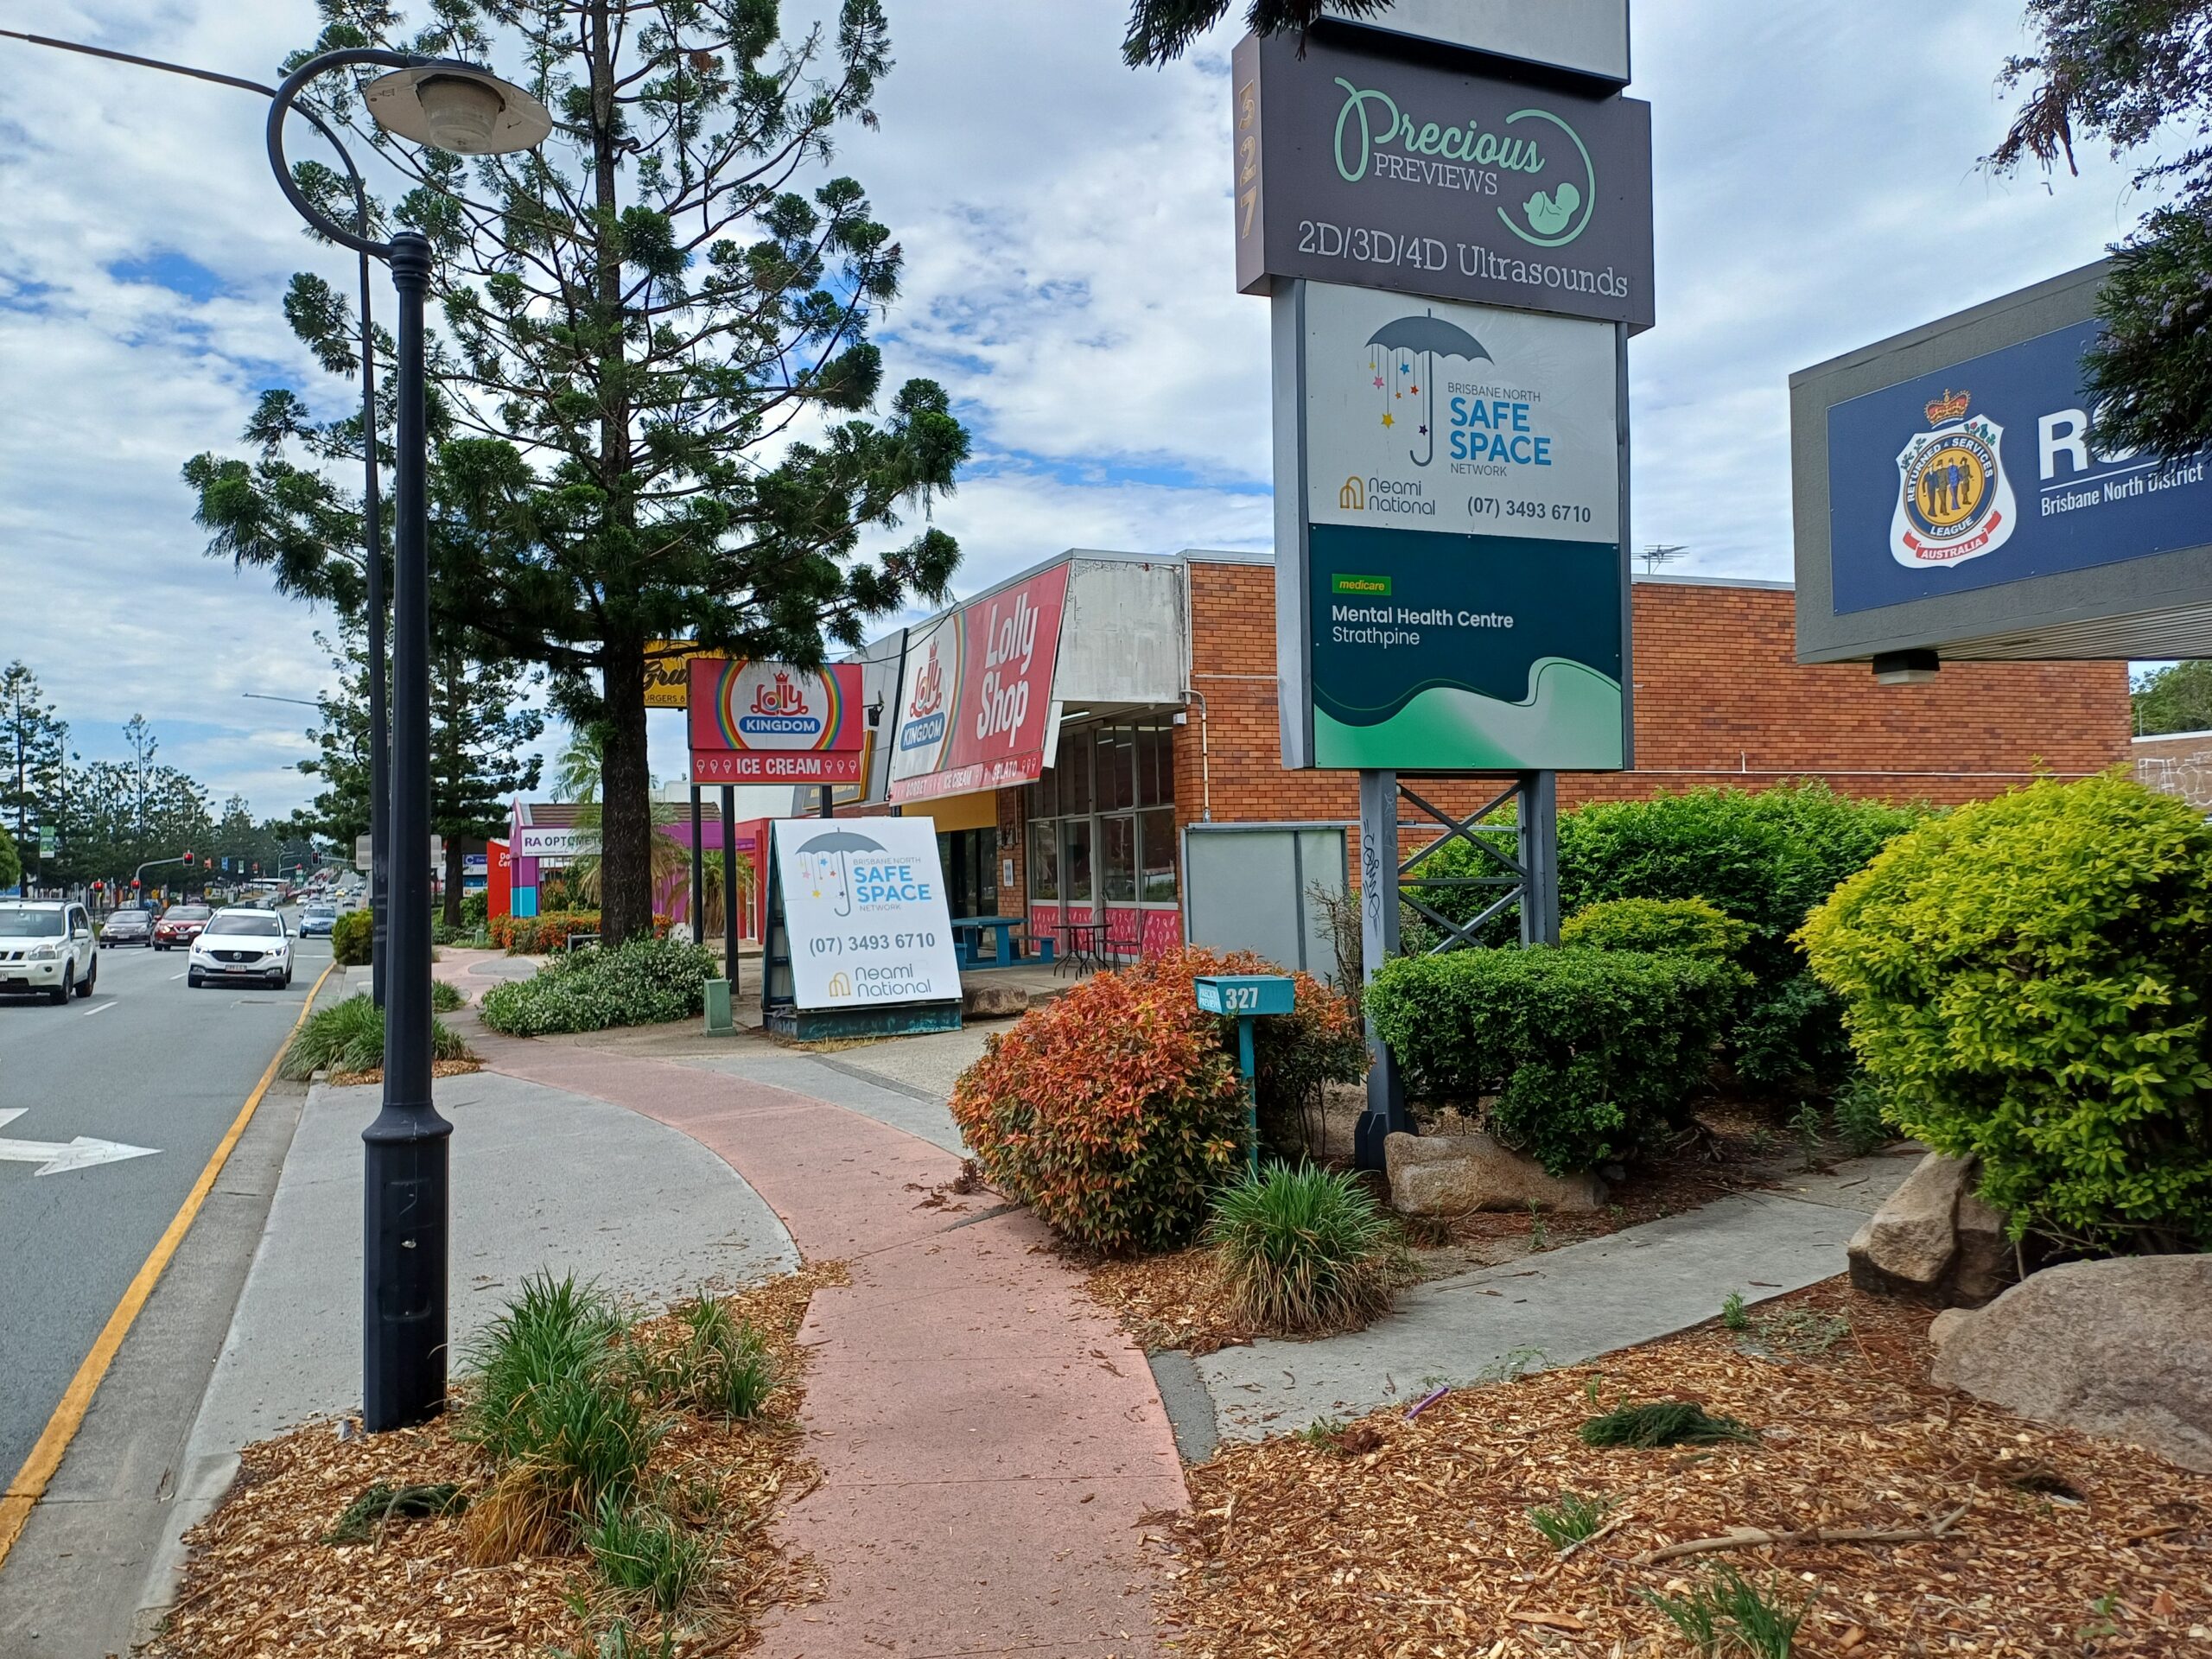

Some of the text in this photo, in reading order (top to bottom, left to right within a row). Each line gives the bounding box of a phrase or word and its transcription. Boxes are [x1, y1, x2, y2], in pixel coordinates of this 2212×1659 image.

[1333, 76, 1545, 182] Precious
[1374, 152, 1497, 195] PREVIEWS
[1298, 219, 1628, 298] 2D/3D/4D Ultrasounds
[1447, 382, 1541, 403] BRISBANE NORTH
[1450, 397, 1530, 432] SAFE
[1450, 429, 1552, 466] SPACE
[1451, 462, 1507, 477] NETWORK
[1907, 444, 1942, 502] RETURNED
[1952, 437, 1993, 478] SERVICES
[2041, 463, 2203, 517] Brisbane North District
[1467, 496, 1592, 523] (07) 3493 6710
[1929, 516, 1974, 537] LEAGUE
[1920, 538, 1984, 559] AUSTRALIA
[1339, 579, 1385, 591] medicare
[1332, 606, 1514, 629] Mental Health Centre
[984, 592, 1039, 676] Lolly
[1332, 626, 1421, 649] Strathpine
[750, 683, 809, 715] Lolly
[910, 658, 943, 717] Lolly
[976, 671, 1030, 748] Shop
[746, 719, 816, 732] KINGDOM
[903, 717, 943, 747] KINGDOM
[736, 758, 821, 776] ICE CREAM
[943, 772, 952, 790] ICE
[952, 769, 972, 789] CREAM
[991, 760, 1018, 781] GELATO
[524, 836, 541, 847] RA
[854, 866, 913, 884] SAFE
[857, 884, 932, 903] SPACE
[860, 904, 901, 912] NETWORK
[810, 932, 936, 957] (07) 3493 6710
[1225, 987, 1258, 1009] 327
